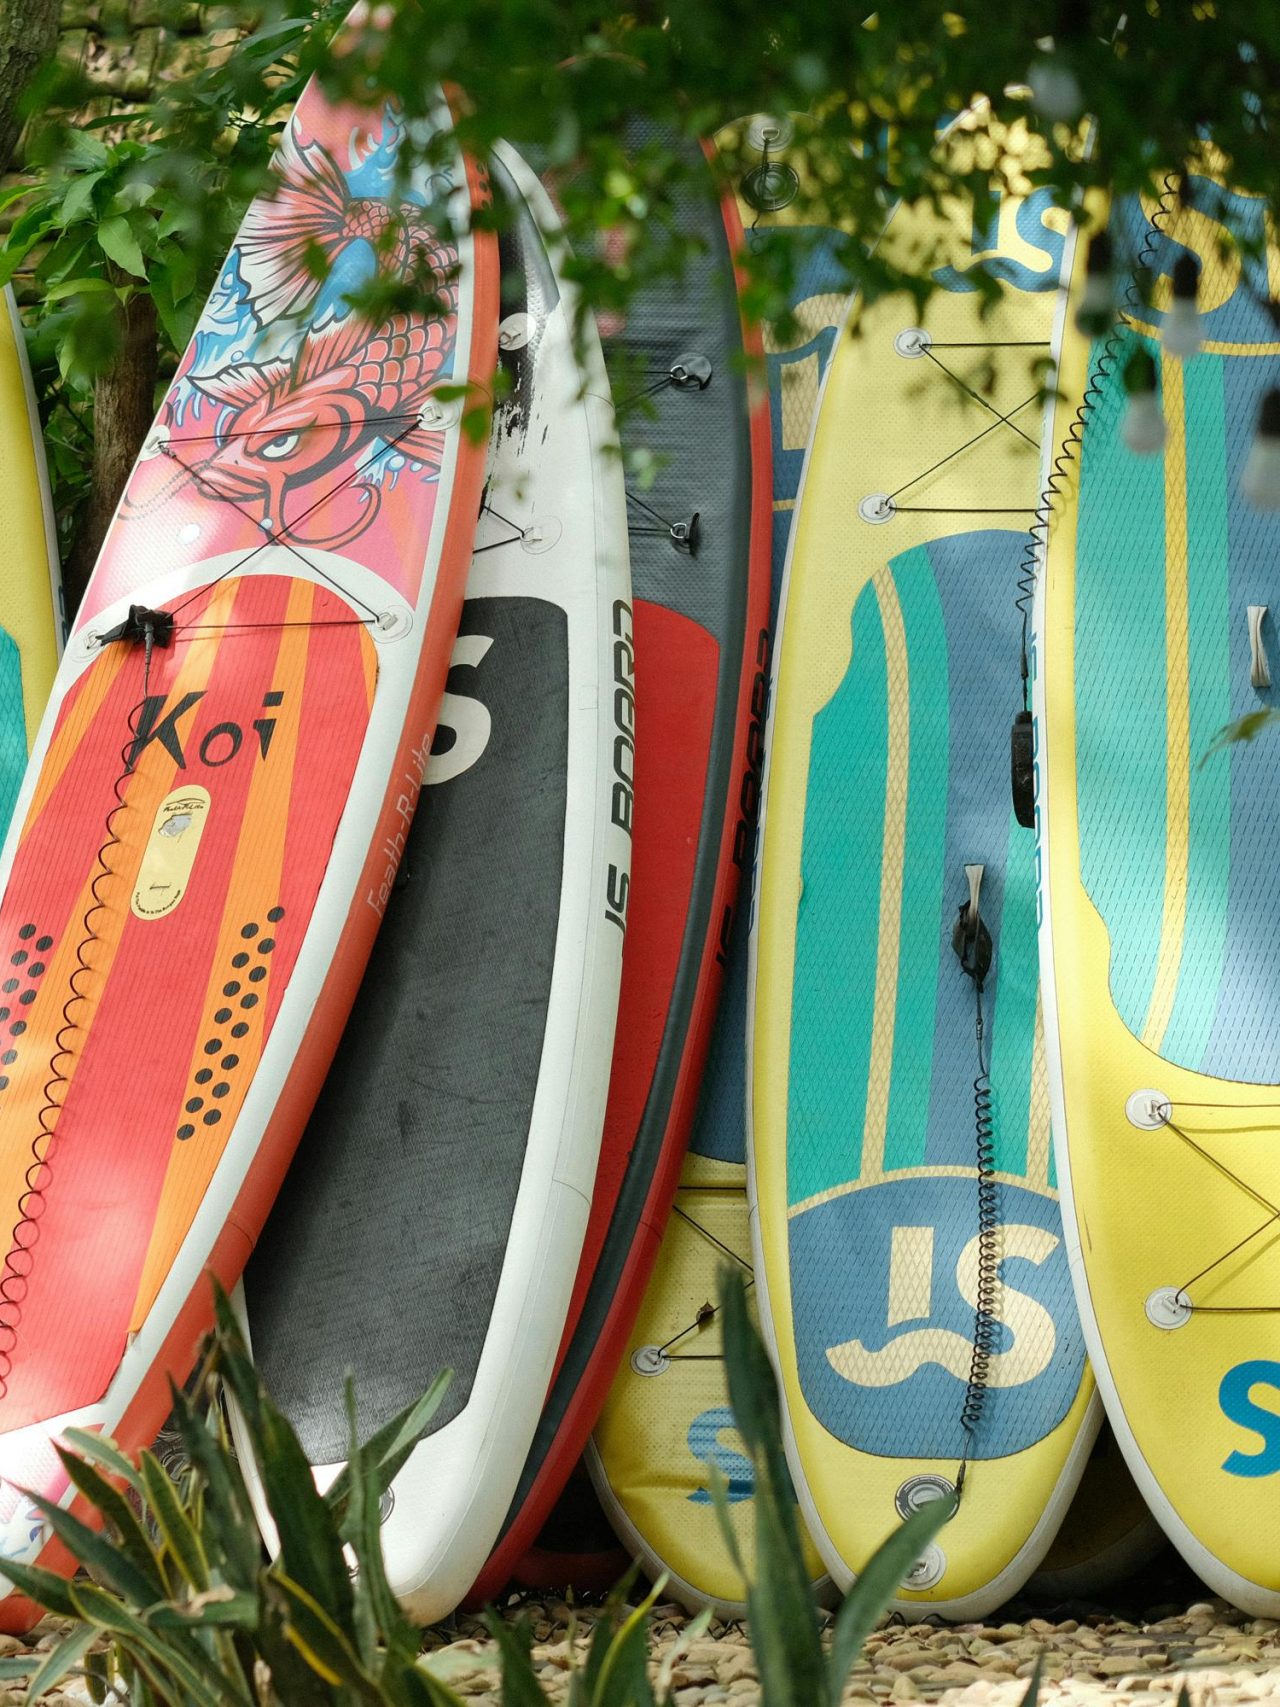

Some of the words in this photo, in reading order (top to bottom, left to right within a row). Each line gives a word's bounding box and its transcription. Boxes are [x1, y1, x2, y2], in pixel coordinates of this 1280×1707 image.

[124, 690, 284, 774] Koi
[611, 599, 636, 838] BOARD
[825, 1223, 1062, 1388] JS
